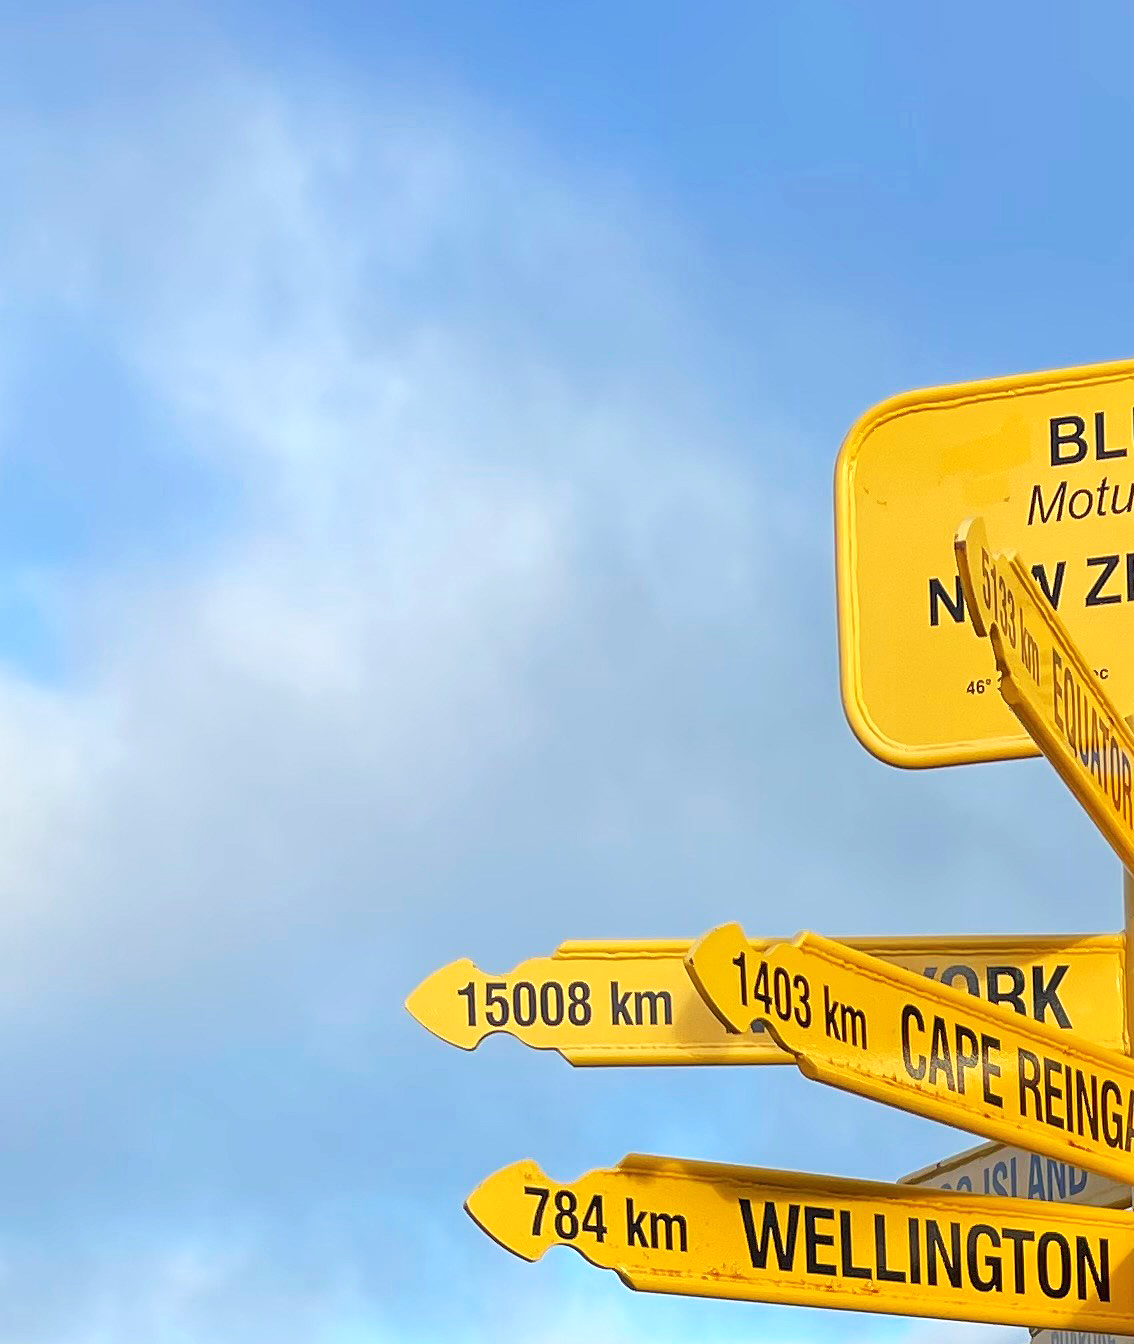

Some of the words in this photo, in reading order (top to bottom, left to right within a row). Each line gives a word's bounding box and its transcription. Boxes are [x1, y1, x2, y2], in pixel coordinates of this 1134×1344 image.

[929, 560, 1066, 627] NW
[981, 546, 1017, 650] 5133
[1019, 607, 1040, 687] km
[1052, 647, 1133, 831] EQUATOR
[457, 981, 592, 1028] 15008
[611, 980, 672, 1026] km
[732, 951, 811, 1028] 1403
[823, 985, 868, 1051] km
[900, 1003, 1004, 1108] CAPE
[983, 1154, 1088, 1202] ISLAND
[523, 1186, 607, 1244] 784
[627, 1198, 688, 1252] km
[738, 1198, 1112, 1303] WELLINGTON
